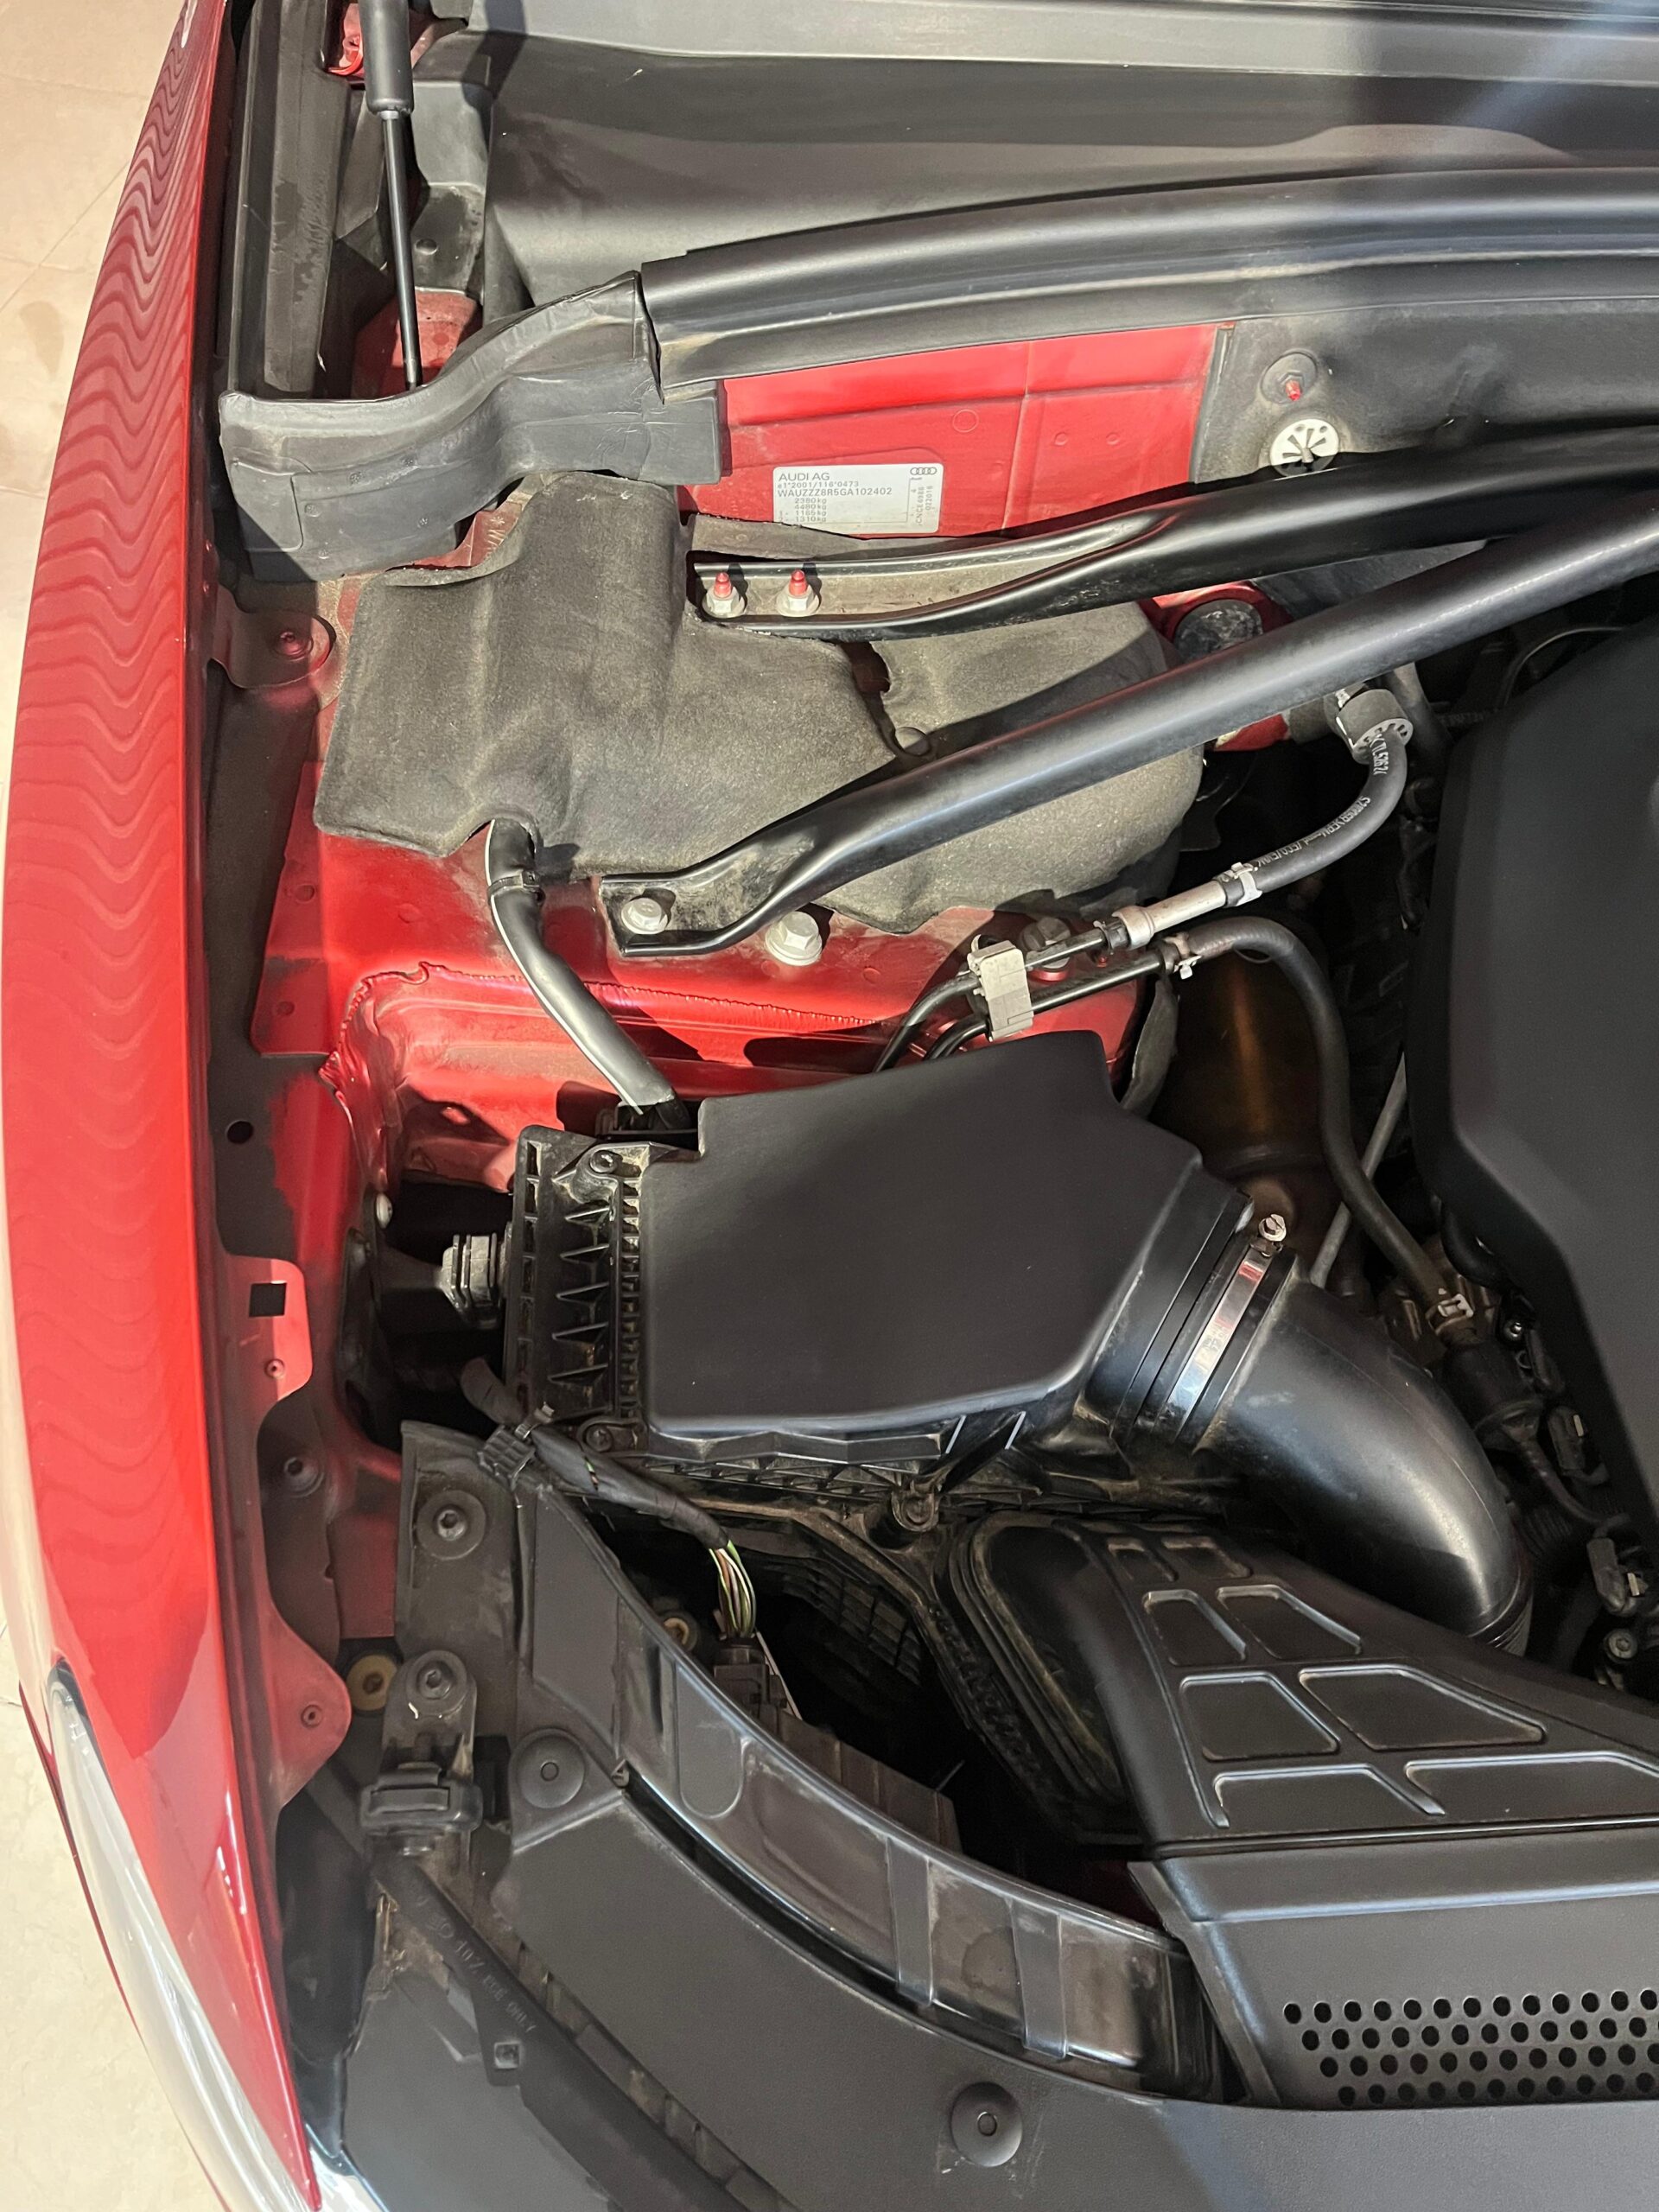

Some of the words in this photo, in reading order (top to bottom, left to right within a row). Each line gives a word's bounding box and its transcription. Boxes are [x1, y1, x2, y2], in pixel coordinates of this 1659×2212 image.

[779, 473, 809, 481] AUDI
[812, 472, 830, 481] AG
[778, 487, 893, 498] WAUZZZ8R5GA102402
